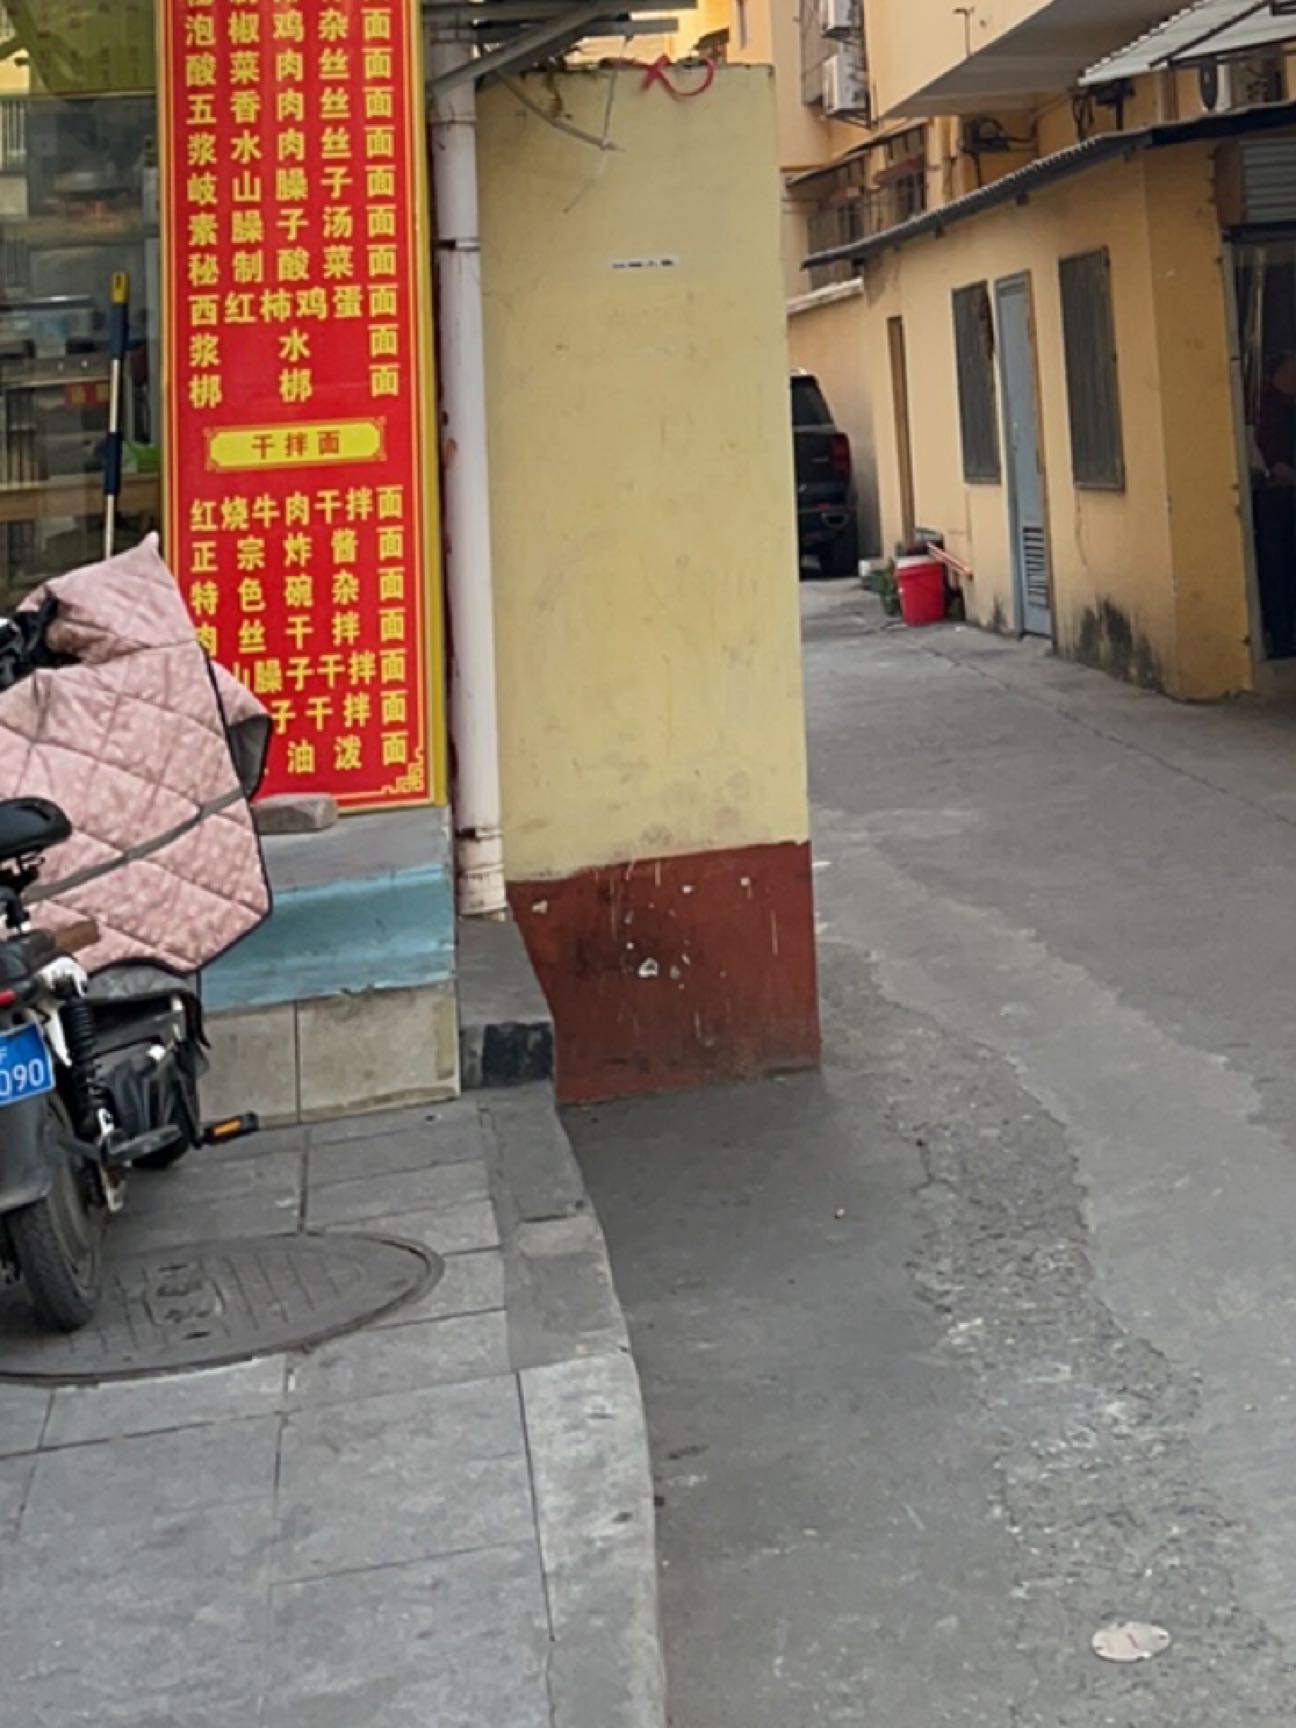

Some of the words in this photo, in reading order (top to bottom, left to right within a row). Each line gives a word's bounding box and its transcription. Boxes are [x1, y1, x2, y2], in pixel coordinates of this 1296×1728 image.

[185, 7, 392, 46] 泡椒鸡杂面
[185, 47, 393, 87] 酸菜肉丝面
[186, 85, 395, 125] 五香肉丝面
[187, 124, 396, 166] 浆水肉丝面
[188, 243, 398, 287] 秘制酸菜面
[187, 282, 399, 327] 西红柿鸡蛋面
[189, 323, 399, 367] 浆水面
[188, 361, 400, 409] 梆梆面
[251, 429, 341, 461] 干拌面
[190, 484, 404, 532] 红烧牛肉干拌面
[191, 525, 405, 573] 正宗炸酱面
[271, 689, 408, 735] 子干拌面
[287, 730, 408, 774] 油泼面
